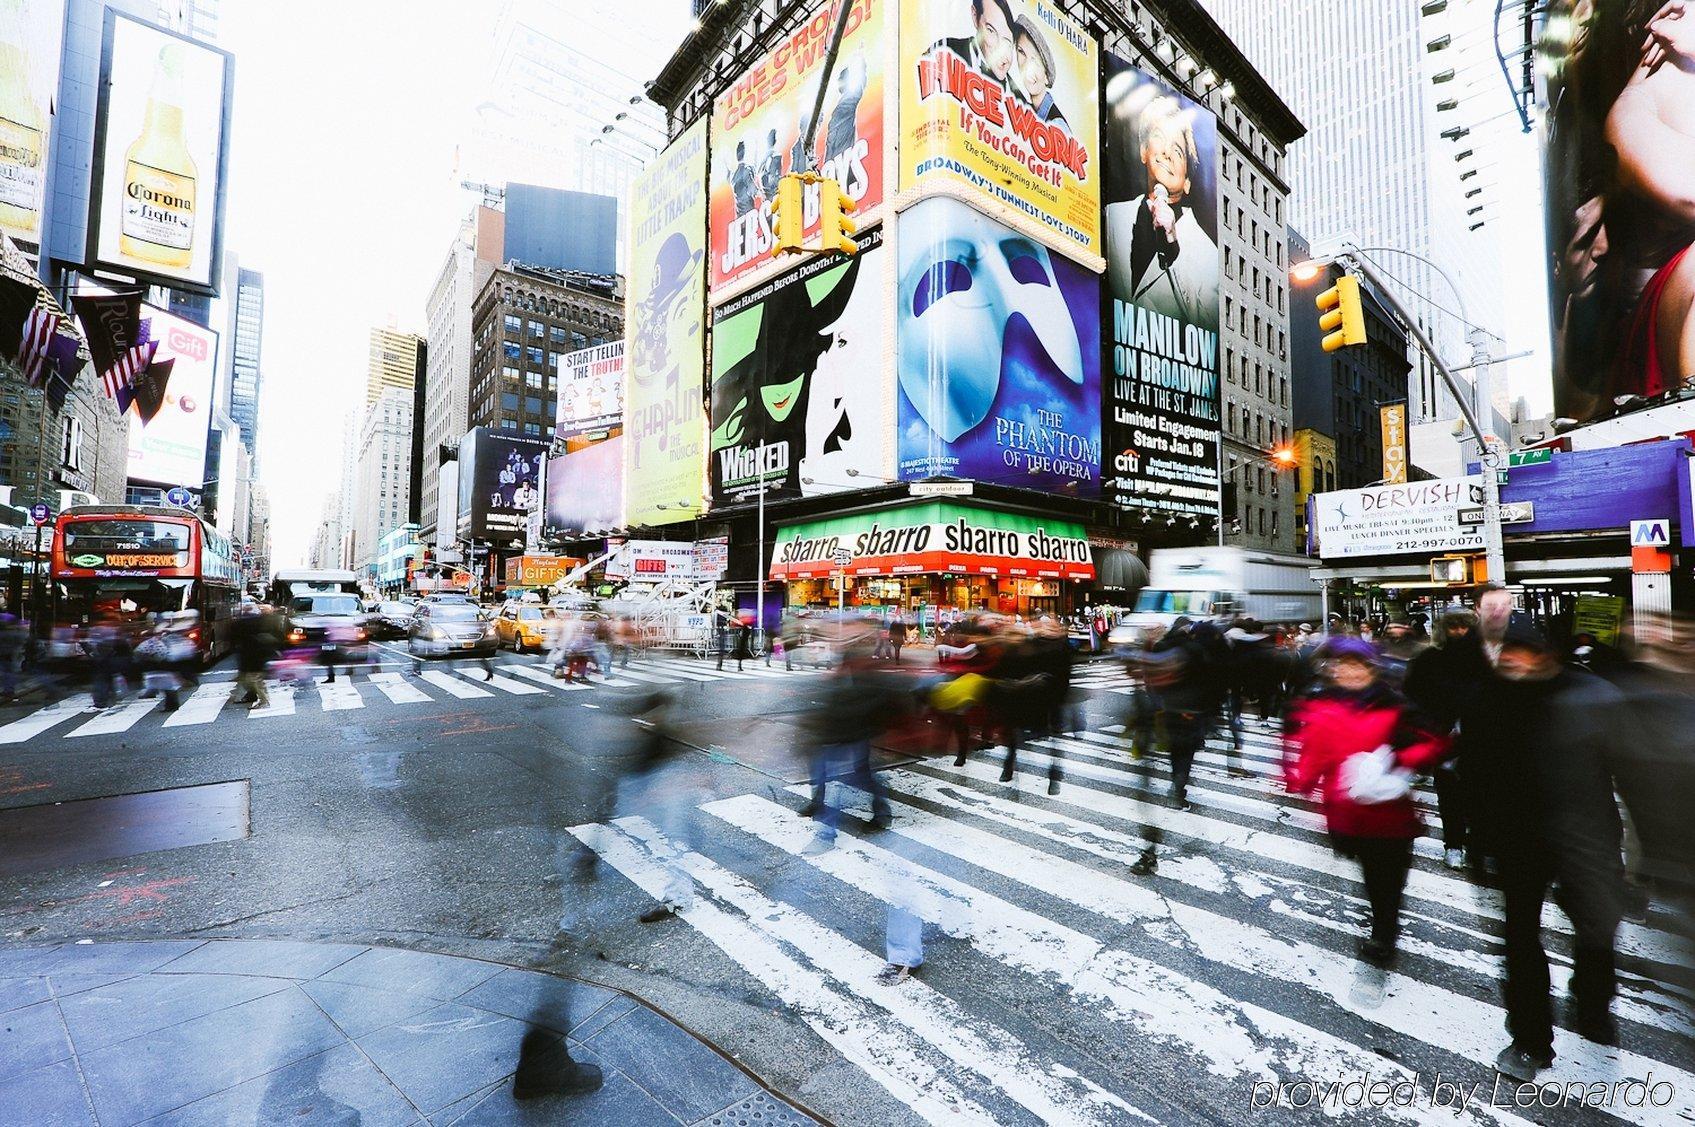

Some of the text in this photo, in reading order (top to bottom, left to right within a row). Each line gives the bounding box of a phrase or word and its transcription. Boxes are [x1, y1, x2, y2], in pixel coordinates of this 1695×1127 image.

[1036, 2, 1088, 55] Kelli O'HARA
[724, 68, 787, 131] GOES
[725, 62, 767, 108] THE
[918, 51, 1089, 181] NICE WORK
[960, 107, 974, 133] If
[976, 119, 1001, 152] You
[1001, 136, 1027, 165] Can
[1027, 156, 1050, 182] Get
[1052, 166, 1063, 188] It
[963, 139, 1058, 204] The Tony-Winning Musical
[127, 181, 193, 212] Corona
[916, 156, 995, 194] BROADWAY'S
[995, 186, 1040, 219] FUNNIEST
[1041, 209, 1064, 232] LOVE
[1065, 222, 1091, 246] STORY
[1113, 299, 1217, 371] MANILOW
[567, 351, 593, 368] START
[573, 357, 624, 380] THE TRUTH!
[1114, 345, 1217, 400] ON BROADWAY
[630, 378, 700, 440] CHAPLIN
[1114, 377, 1219, 422] LIVE AT THE ST. JAMES
[1036, 408, 1063, 428] THE
[1114, 406, 1220, 442] Limited Engagement
[994, 416, 1099, 466] PHANTOM
[1133, 430, 1168, 452] Starts
[1003, 449, 1091, 481] OF THE OPERA
[1114, 454, 1141, 473] citi
[1516, 450, 1543, 465] 7 AV
[1361, 483, 1461, 511] DERVISH
[780, 536, 839, 564] sbarro
[854, 523, 931, 557] sbarro
[946, 519, 1019, 557] sbarro
[1028, 529, 1087, 562] sbarro
[1343, 523, 1365, 532] MUSIC
[1379, 528, 1411, 538] DINNER
[1413, 525, 1455, 535] SPECIALS
[1396, 535, 1483, 550] 212-997-0070
[106, 555, 124, 566] OUT
[129, 555, 141, 567] OF
[525, 567, 564, 579] GIFTS
[636, 559, 666, 572] GIFTS
